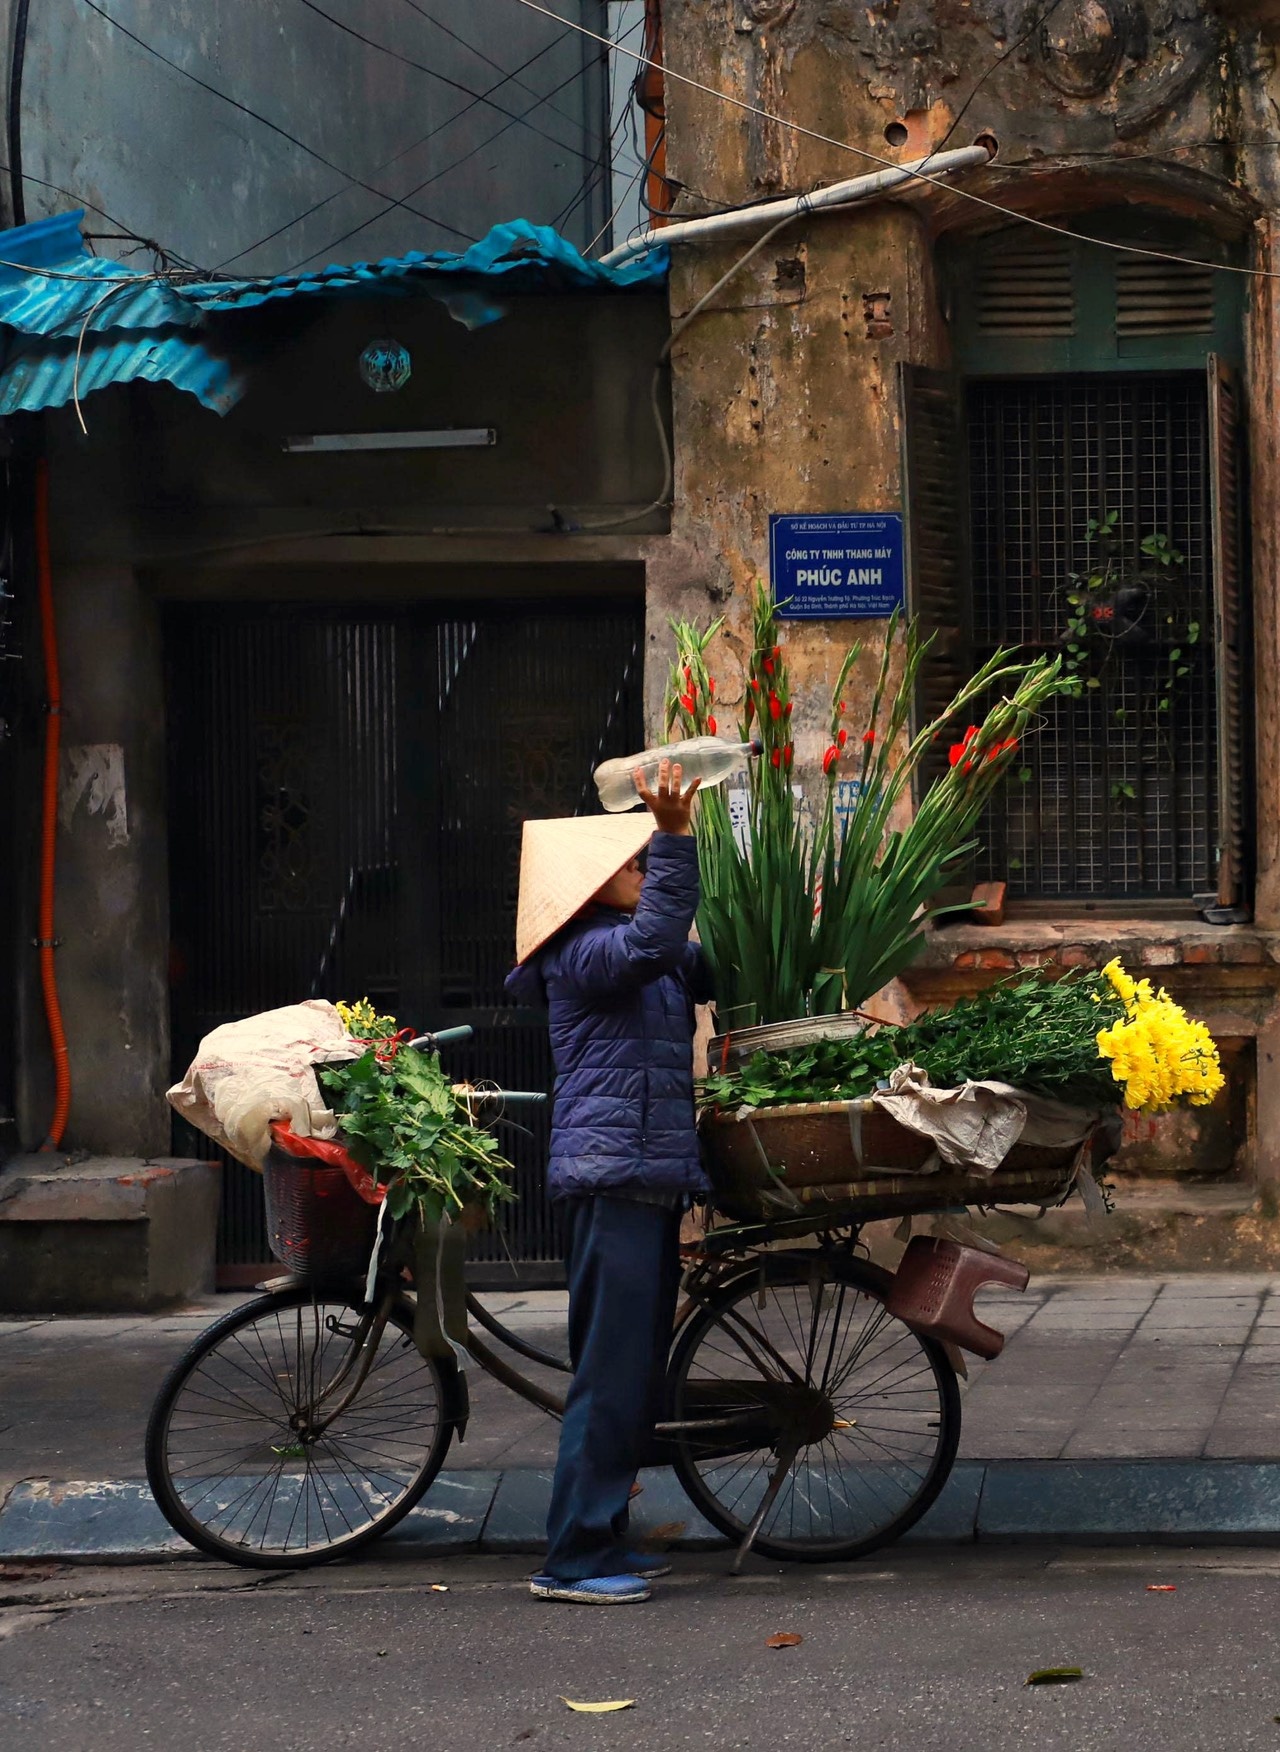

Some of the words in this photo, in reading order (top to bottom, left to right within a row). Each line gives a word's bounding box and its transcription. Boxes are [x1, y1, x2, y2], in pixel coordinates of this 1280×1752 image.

[785, 548, 808, 560] CÔNG
[809, 549, 820, 560] TY
[822, 549, 844, 559] TNHH
[846, 548, 873, 559] THANG
[874, 546, 892, 559] MÁY
[796, 564, 843, 587] PHÚC
[847, 568, 882, 586] ANH
